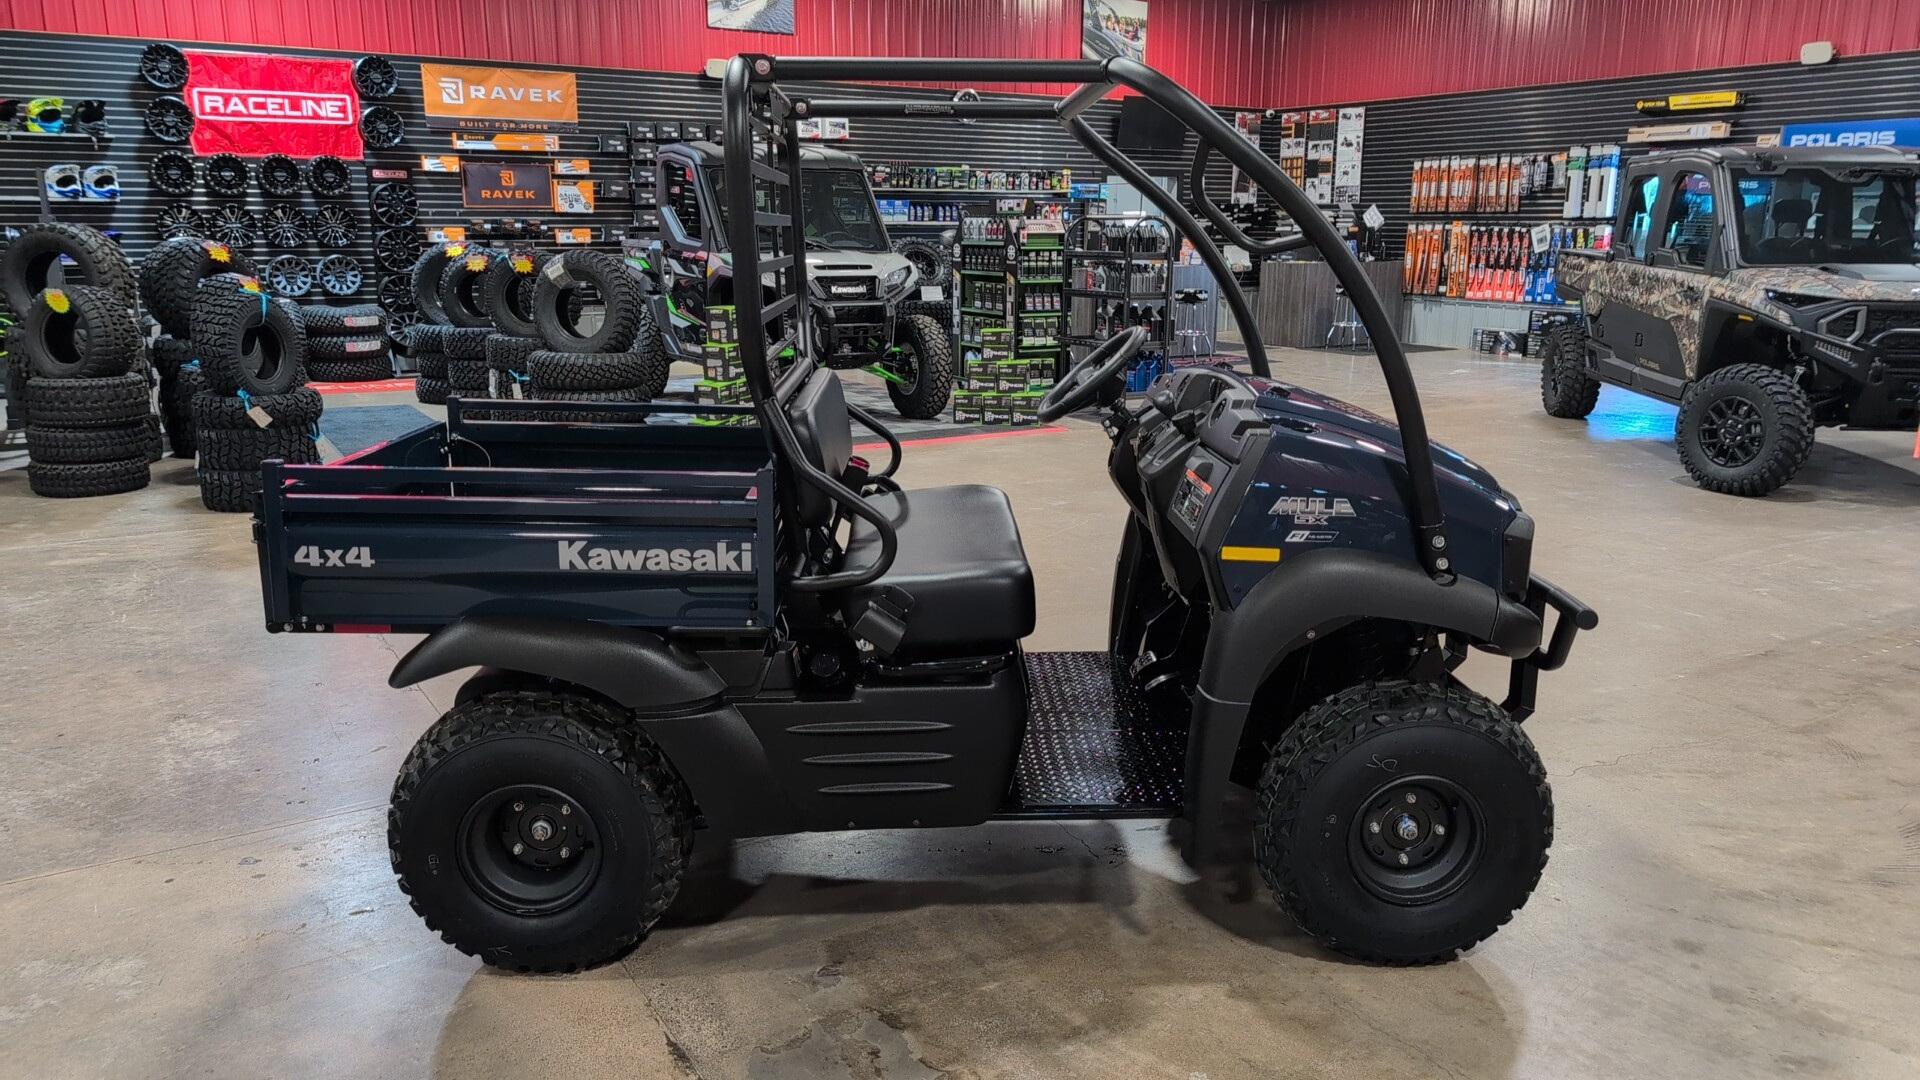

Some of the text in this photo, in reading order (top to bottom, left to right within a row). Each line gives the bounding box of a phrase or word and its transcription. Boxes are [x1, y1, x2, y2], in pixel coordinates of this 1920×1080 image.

[470, 85, 563, 103] RAVEK
[203, 95, 345, 118] RACELINE
[459, 120, 490, 128] BUILT
[520, 122, 549, 130] MORE
[1790, 130, 1896, 147] POLARIS
[481, 189, 536, 199] RAVEK
[831, 285, 867, 294] Kawasaki
[1268, 496, 1357, 517] MULE
[1294, 514, 1328, 525] SX
[294, 544, 375, 568] 4x4
[557, 539, 752, 572] Kawasaki
